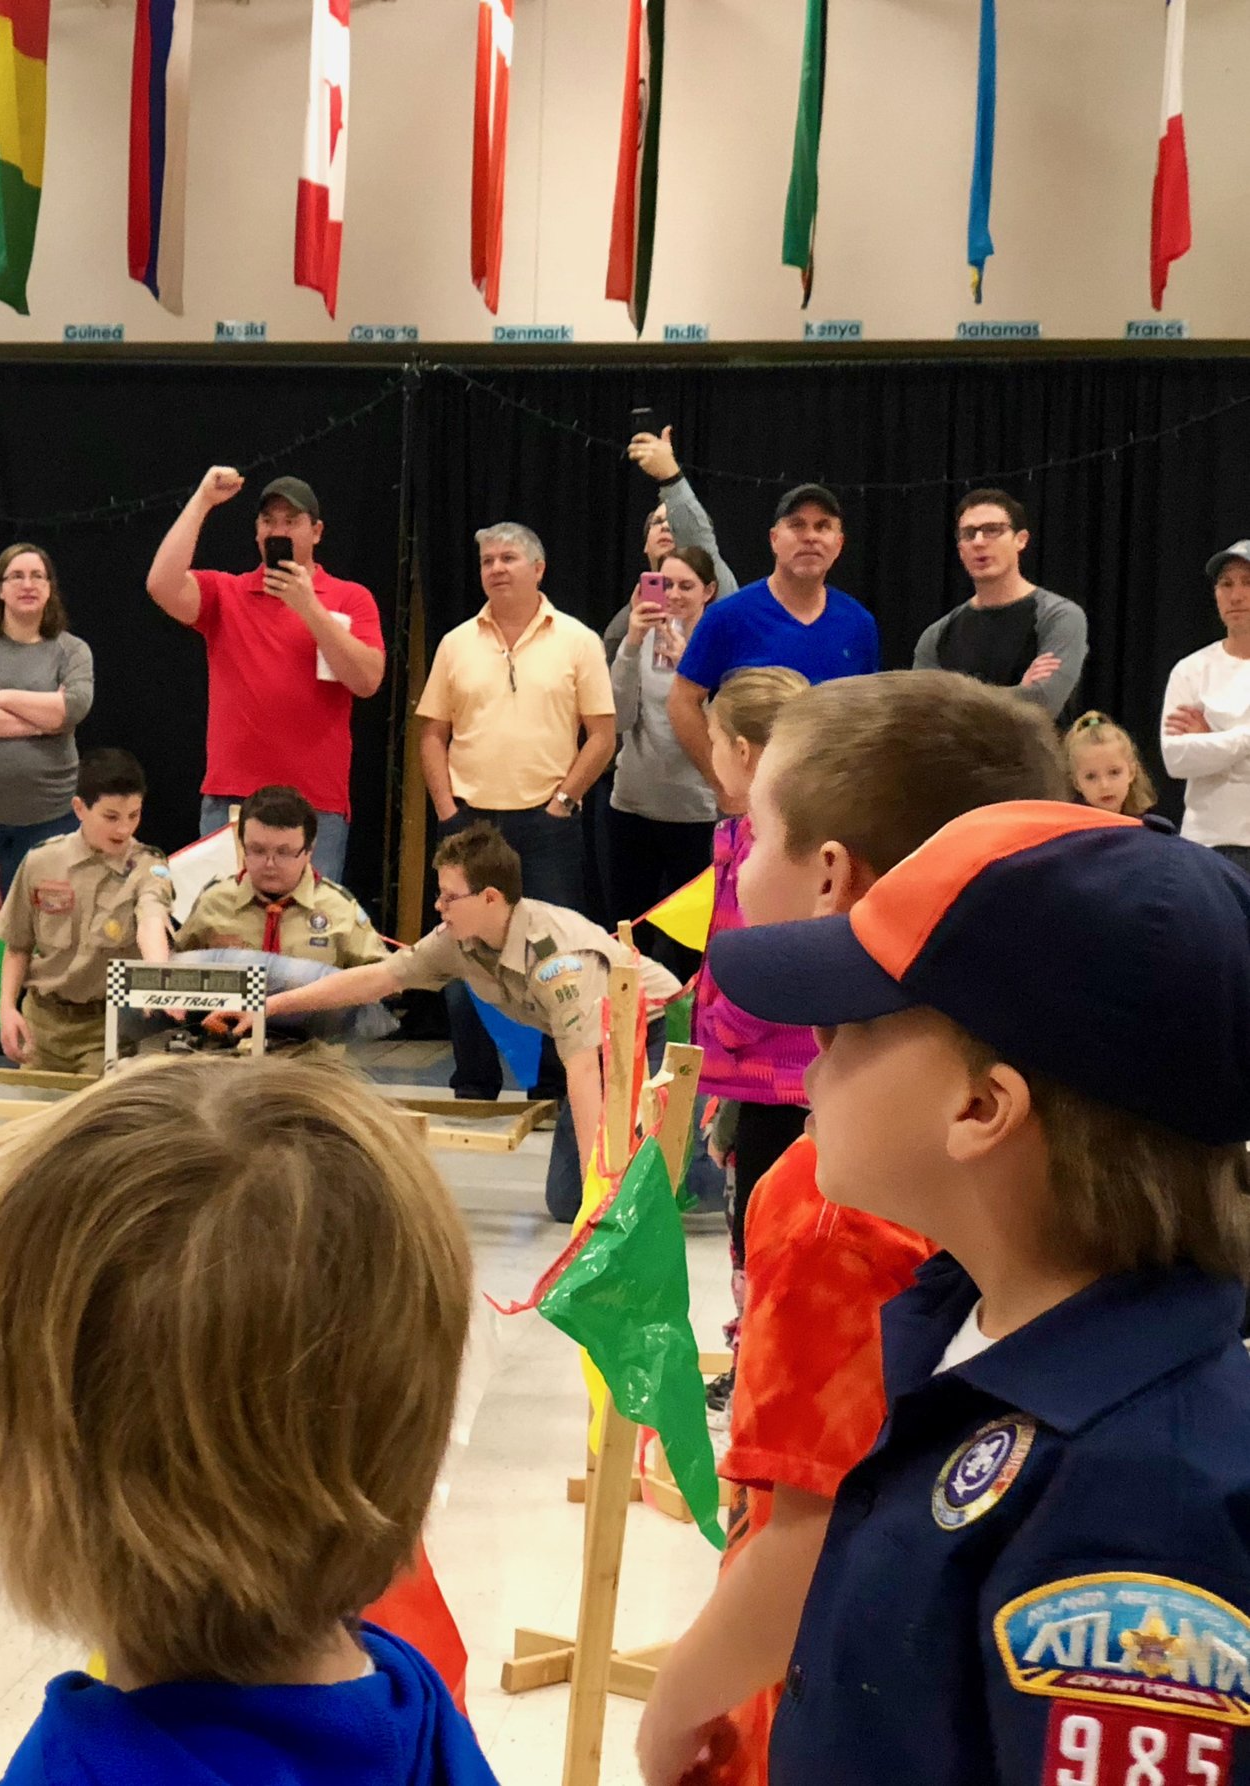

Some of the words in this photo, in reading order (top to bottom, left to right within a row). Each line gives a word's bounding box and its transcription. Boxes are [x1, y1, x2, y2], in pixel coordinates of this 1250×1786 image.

[64, 325, 123, 339] Guinea
[494, 325, 570, 340] Denmark
[805, 321, 860, 338] Kenya
[958, 321, 1040, 337] Bahamas
[144, 994, 180, 1006] FAST
[182, 996, 229, 1008] TRACK
[1056, 1714, 1223, 1786] 985
